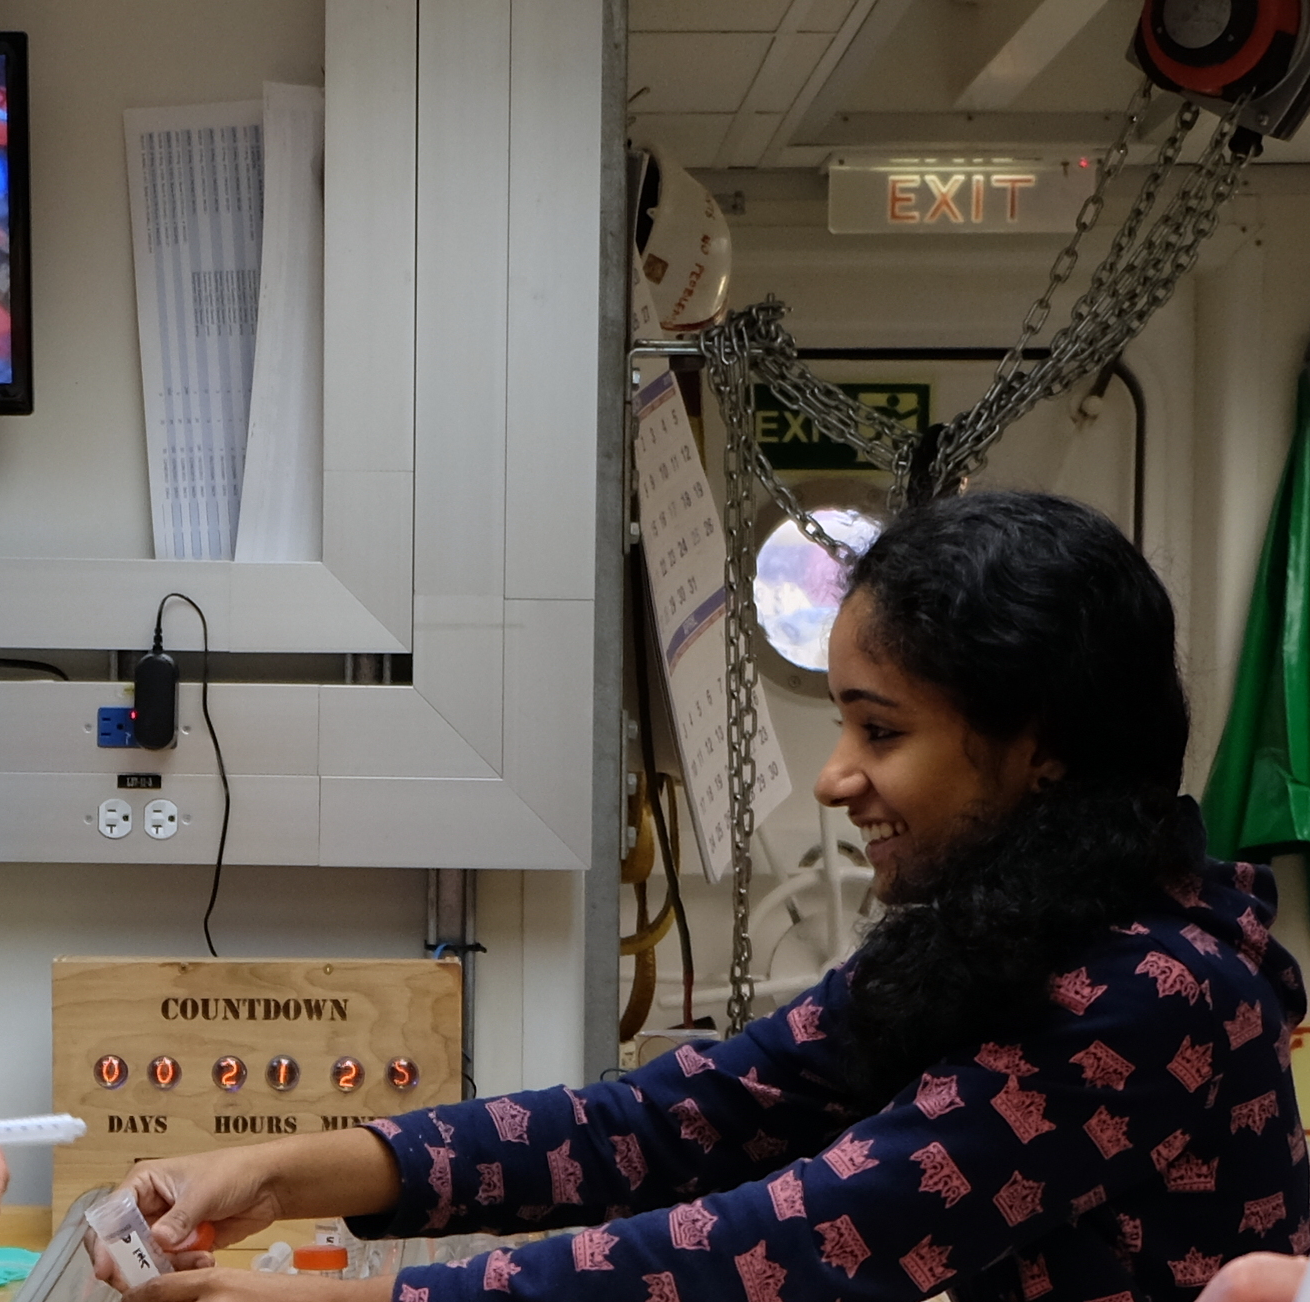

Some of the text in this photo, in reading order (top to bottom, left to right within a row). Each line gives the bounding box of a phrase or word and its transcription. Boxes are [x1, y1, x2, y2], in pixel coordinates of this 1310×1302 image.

[888, 174, 1037, 223] EXIT
[160, 997, 350, 1021] COUNTDOWN
[108, 1115, 168, 1134] DAYS
[214, 1115, 297, 1134] HOURS
